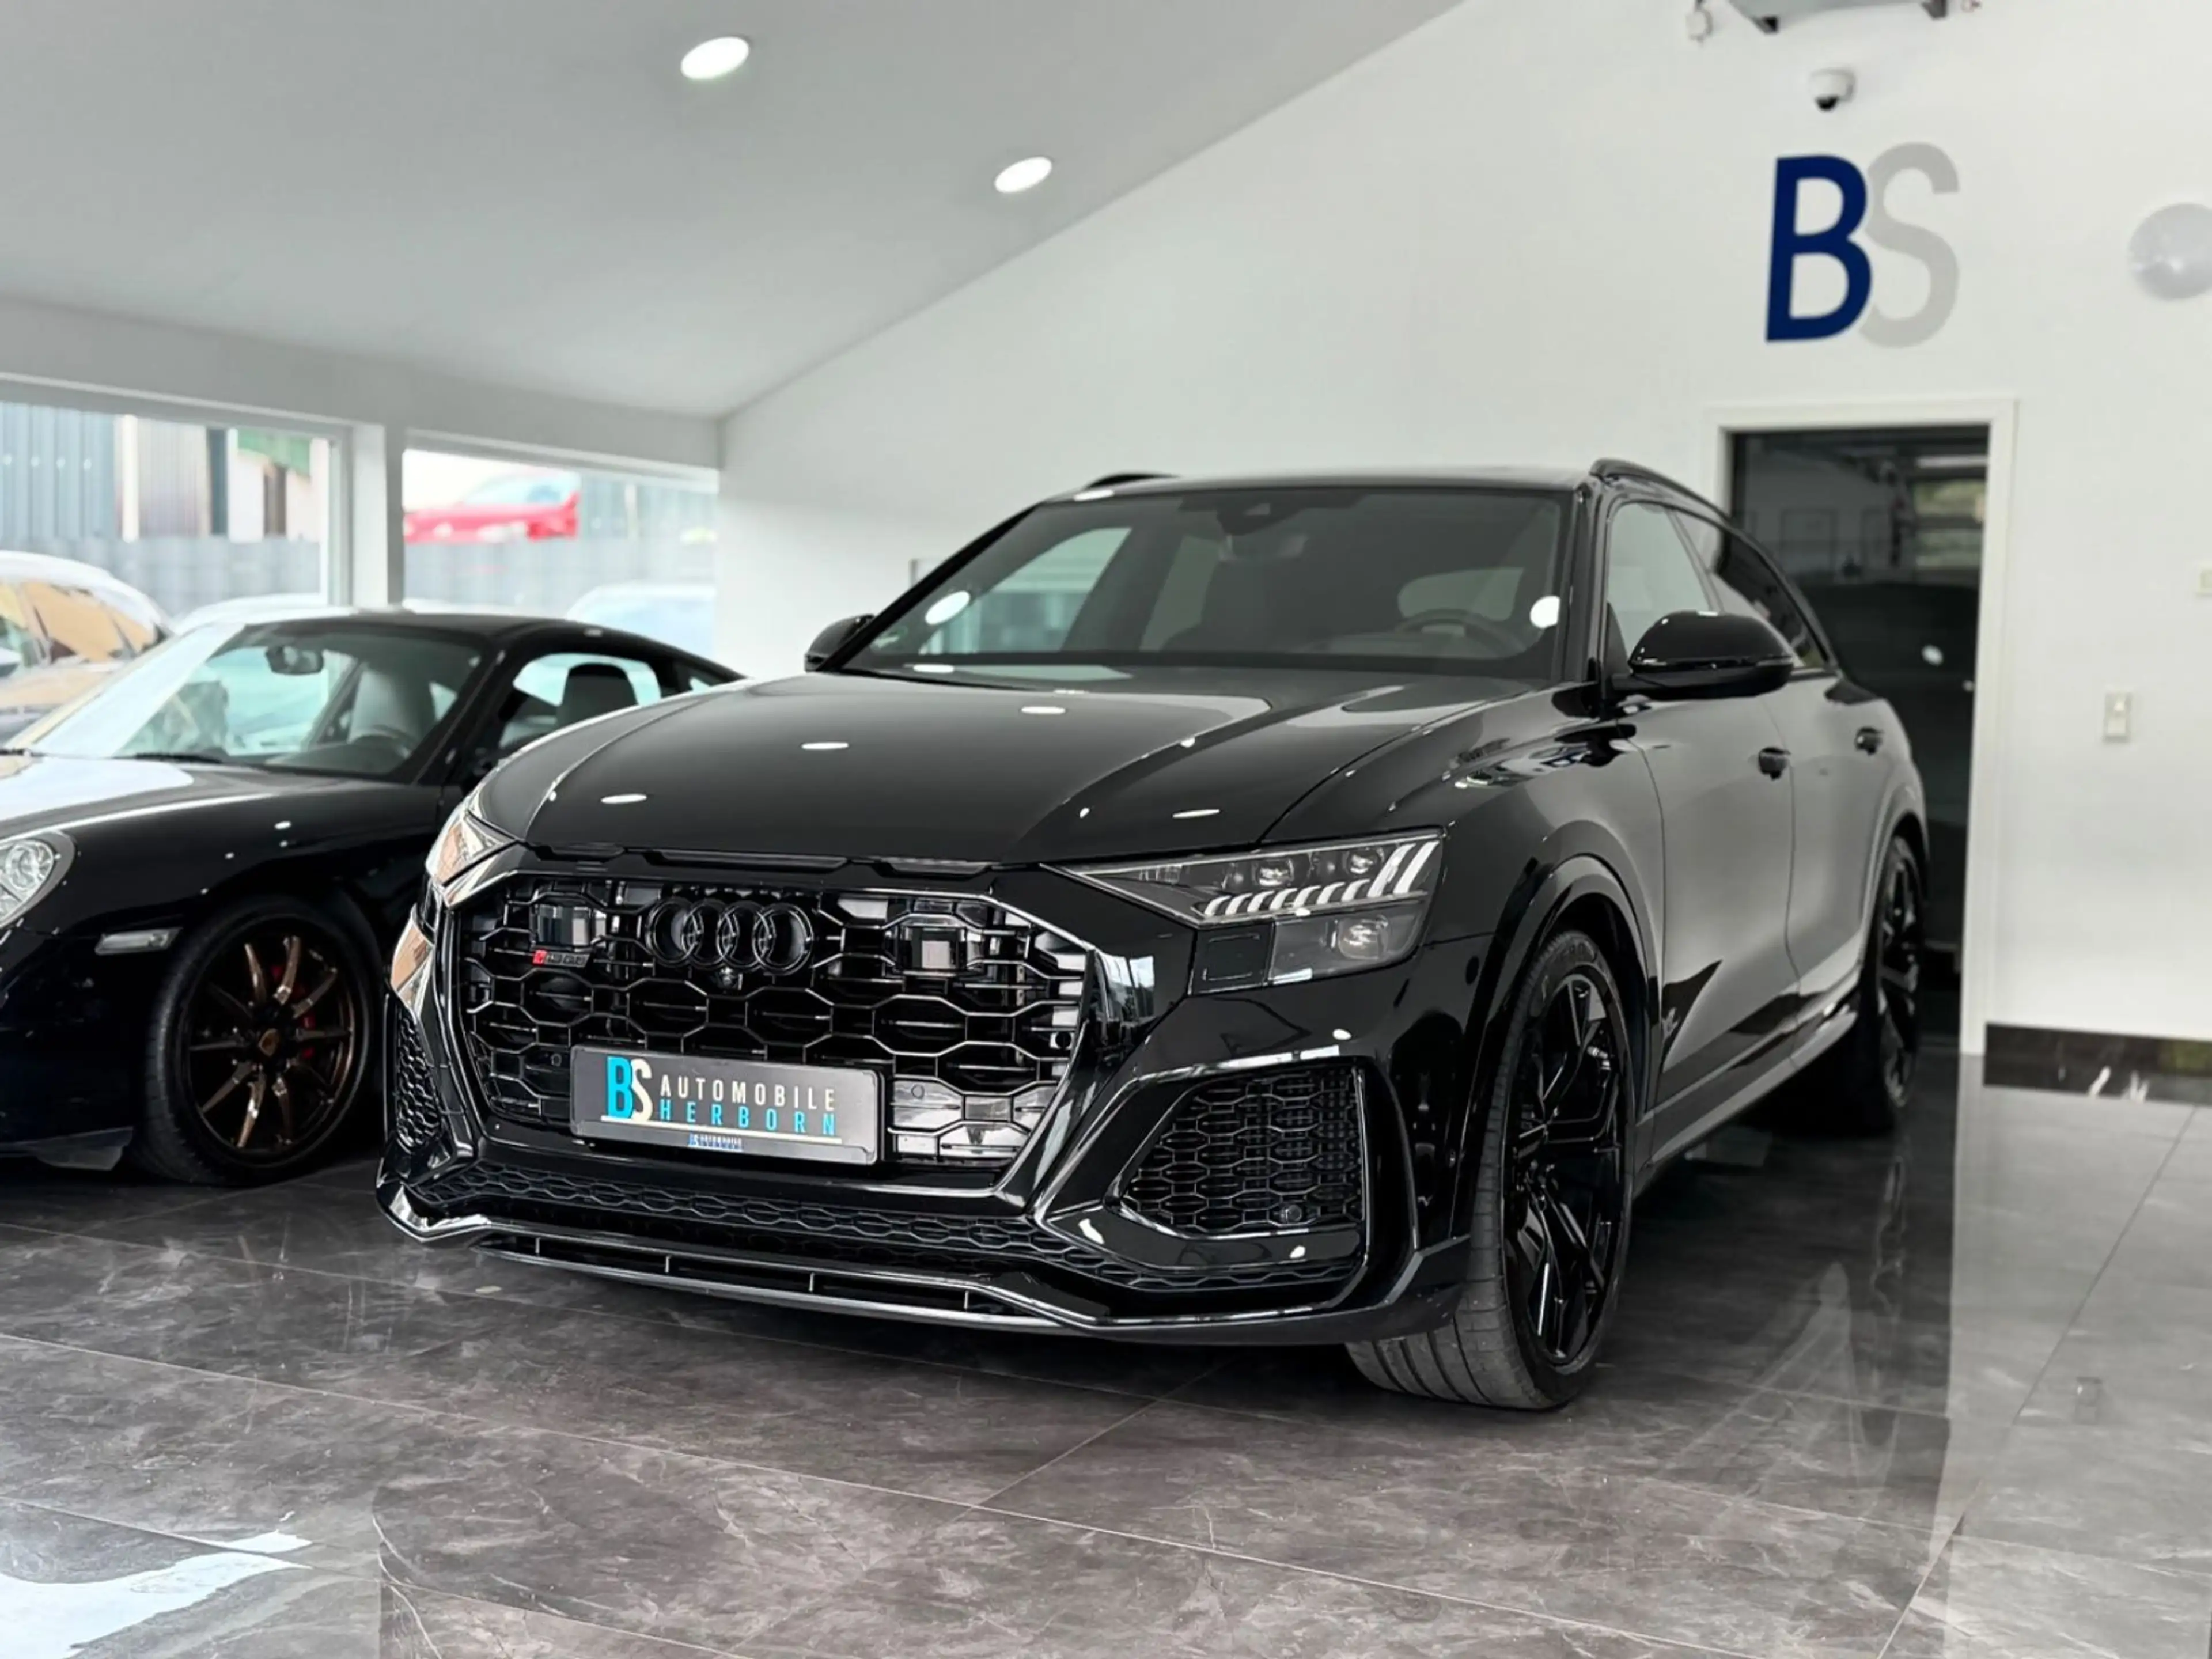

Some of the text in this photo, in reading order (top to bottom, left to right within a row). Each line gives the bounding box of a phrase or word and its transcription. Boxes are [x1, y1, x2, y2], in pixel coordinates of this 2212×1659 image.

[1765, 142, 1960, 348] BS
[607, 1056, 654, 1122] BS
[660, 1074, 835, 1112] AUTOMOBILE
[660, 1098, 835, 1136] HERBORN
